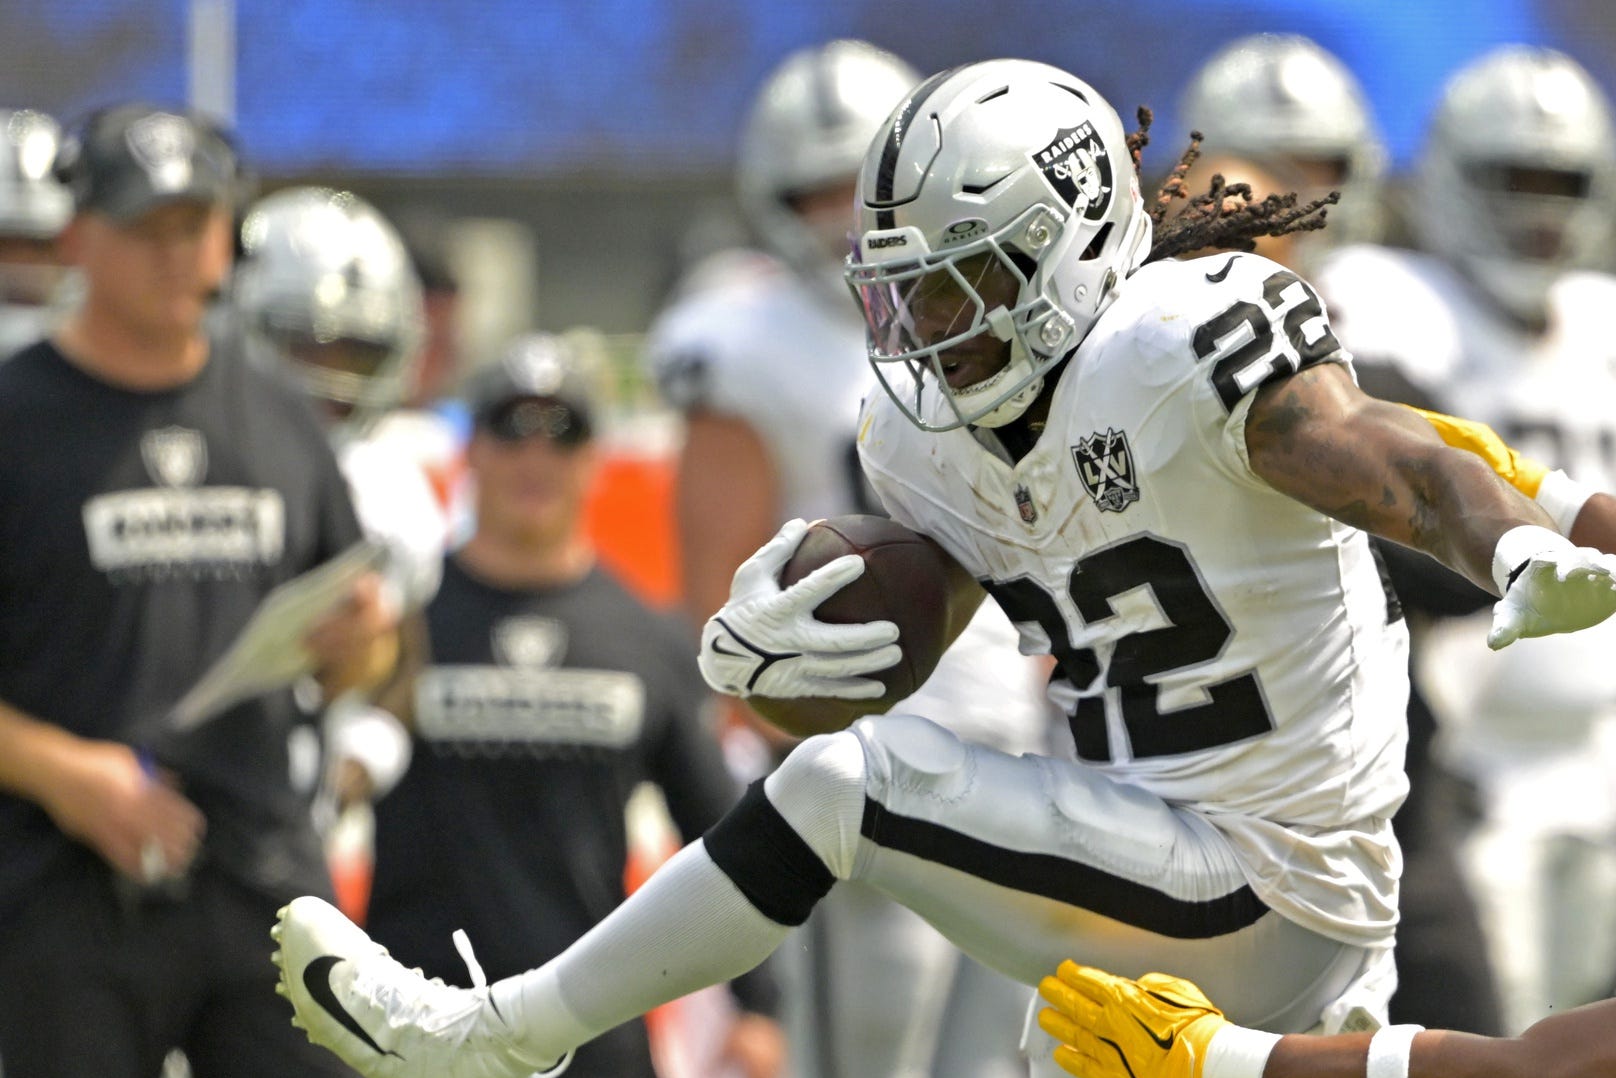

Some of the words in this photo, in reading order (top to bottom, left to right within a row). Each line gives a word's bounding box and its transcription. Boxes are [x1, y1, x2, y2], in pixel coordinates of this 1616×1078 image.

[1040, 123, 1092, 164] RAIDERS
[944, 227, 987, 244] OAKLEY
[1191, 270, 1342, 414] 22
